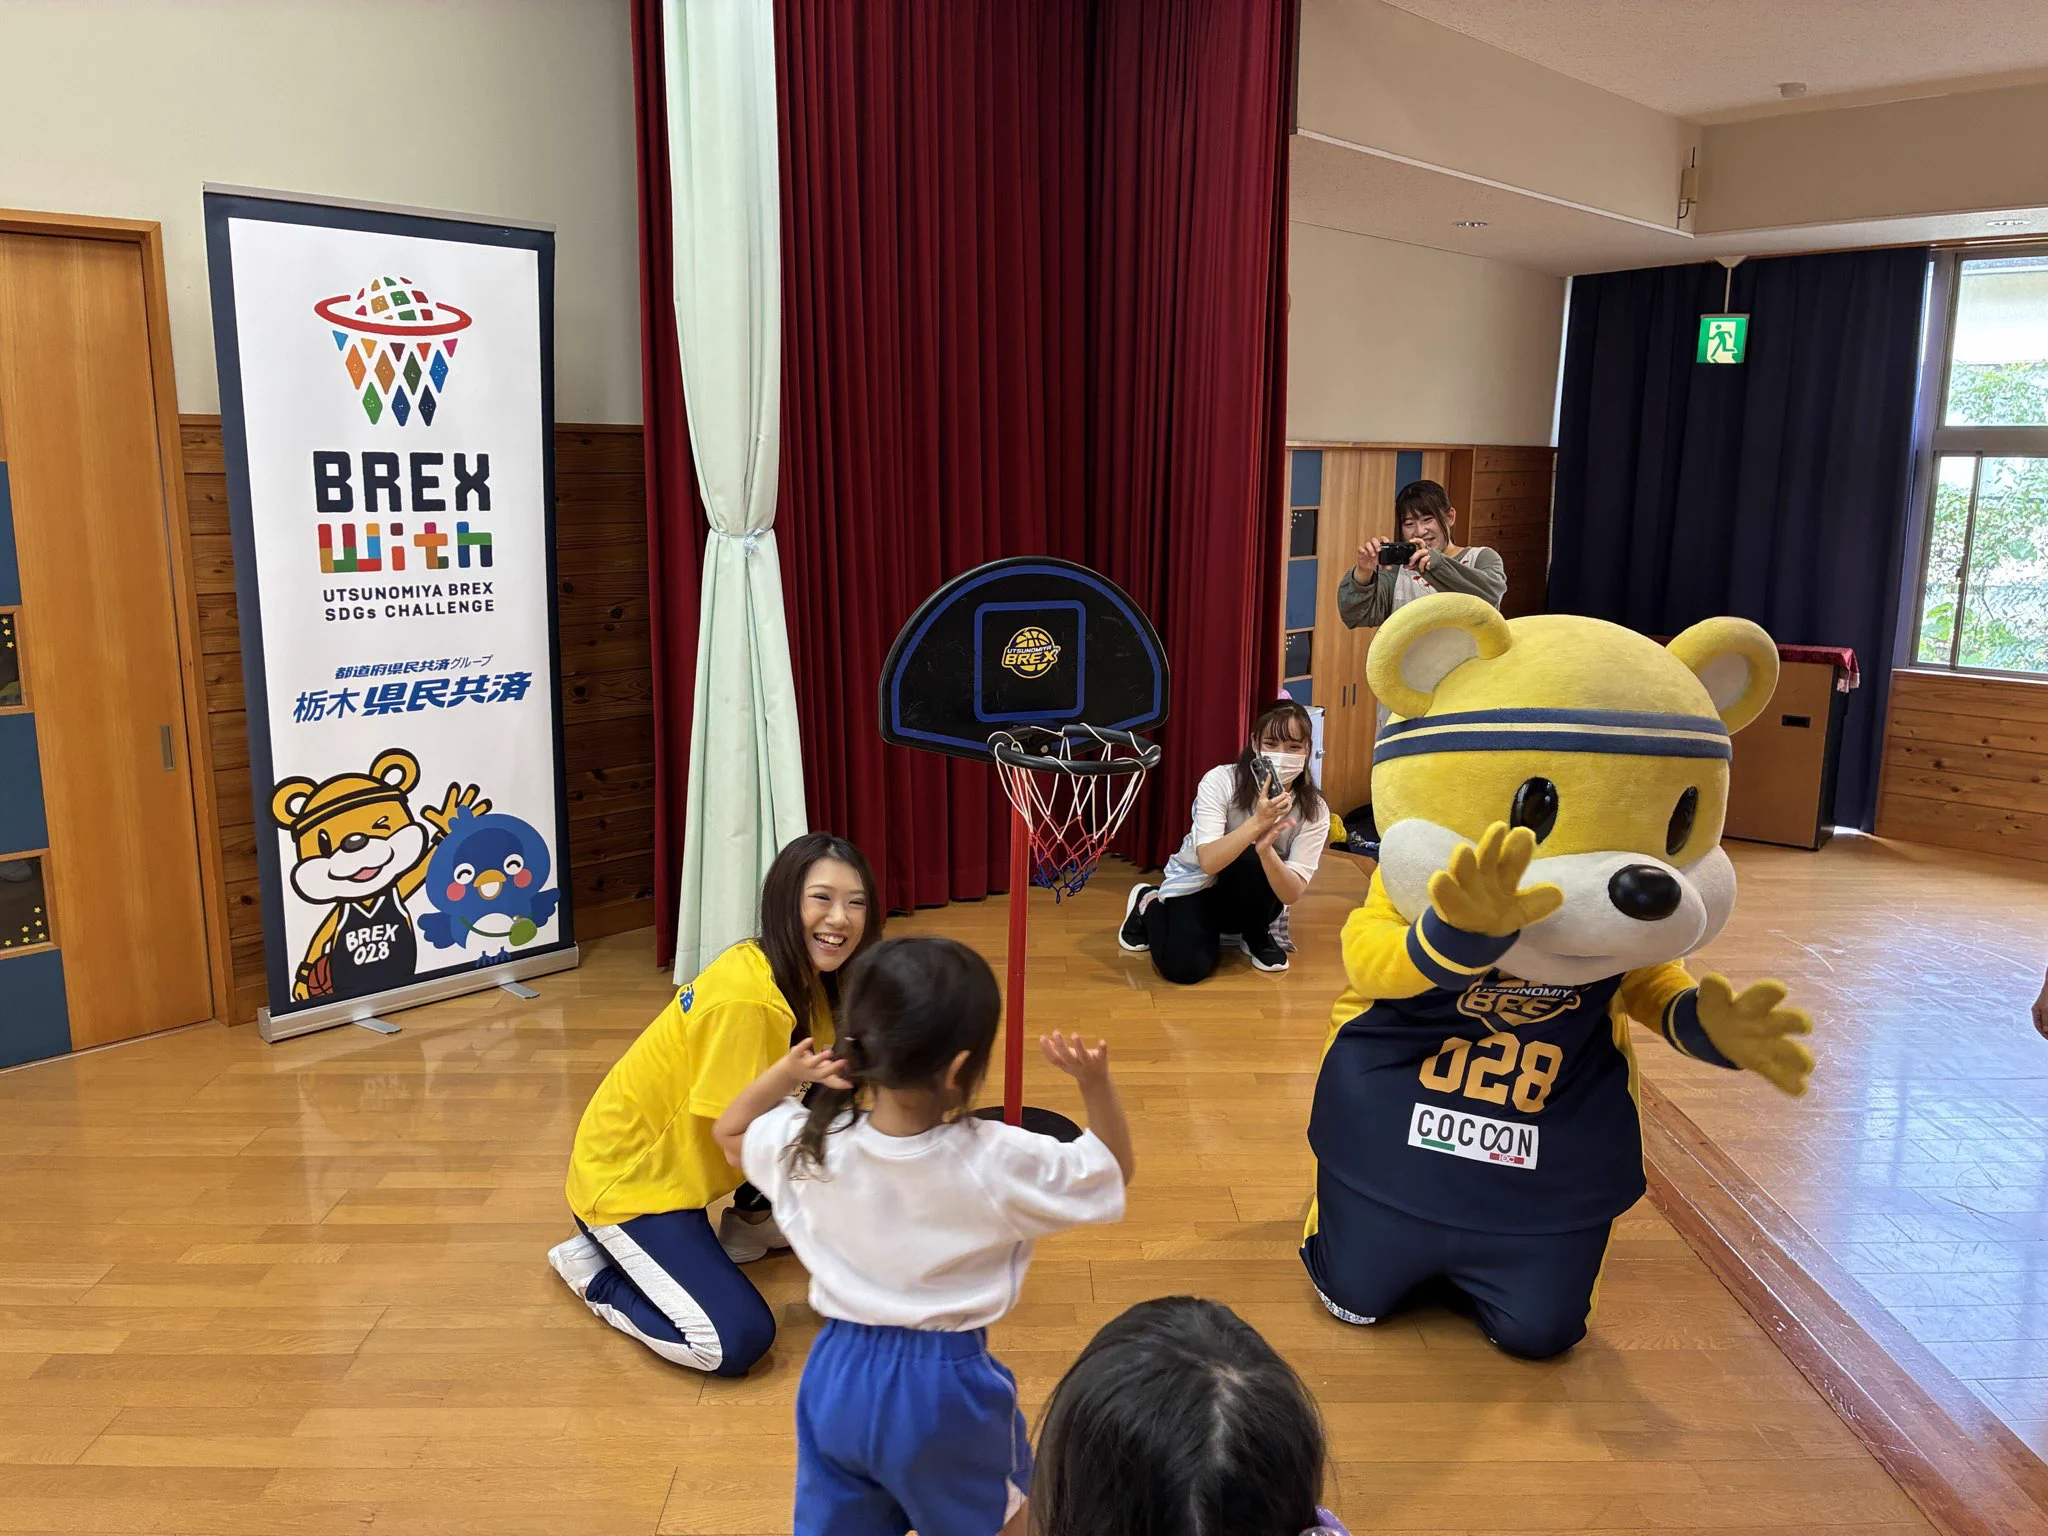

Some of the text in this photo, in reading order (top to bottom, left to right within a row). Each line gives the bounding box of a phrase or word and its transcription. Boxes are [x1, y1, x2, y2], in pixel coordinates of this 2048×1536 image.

[313, 450, 491, 513] BREX
[323, 581, 494, 603] UTSUNOMIYA BREX
[325, 599, 495, 622] SDGs CHALLENGE
[335, 654, 494, 680] 都道府県民共済グループ
[1004, 650, 1056, 665] BREX
[293, 671, 533, 724] 栃木県民共済
[345, 923, 399, 953] BREX
[353, 941, 390, 966] 028
[1418, 1031, 1564, 1114] 028
